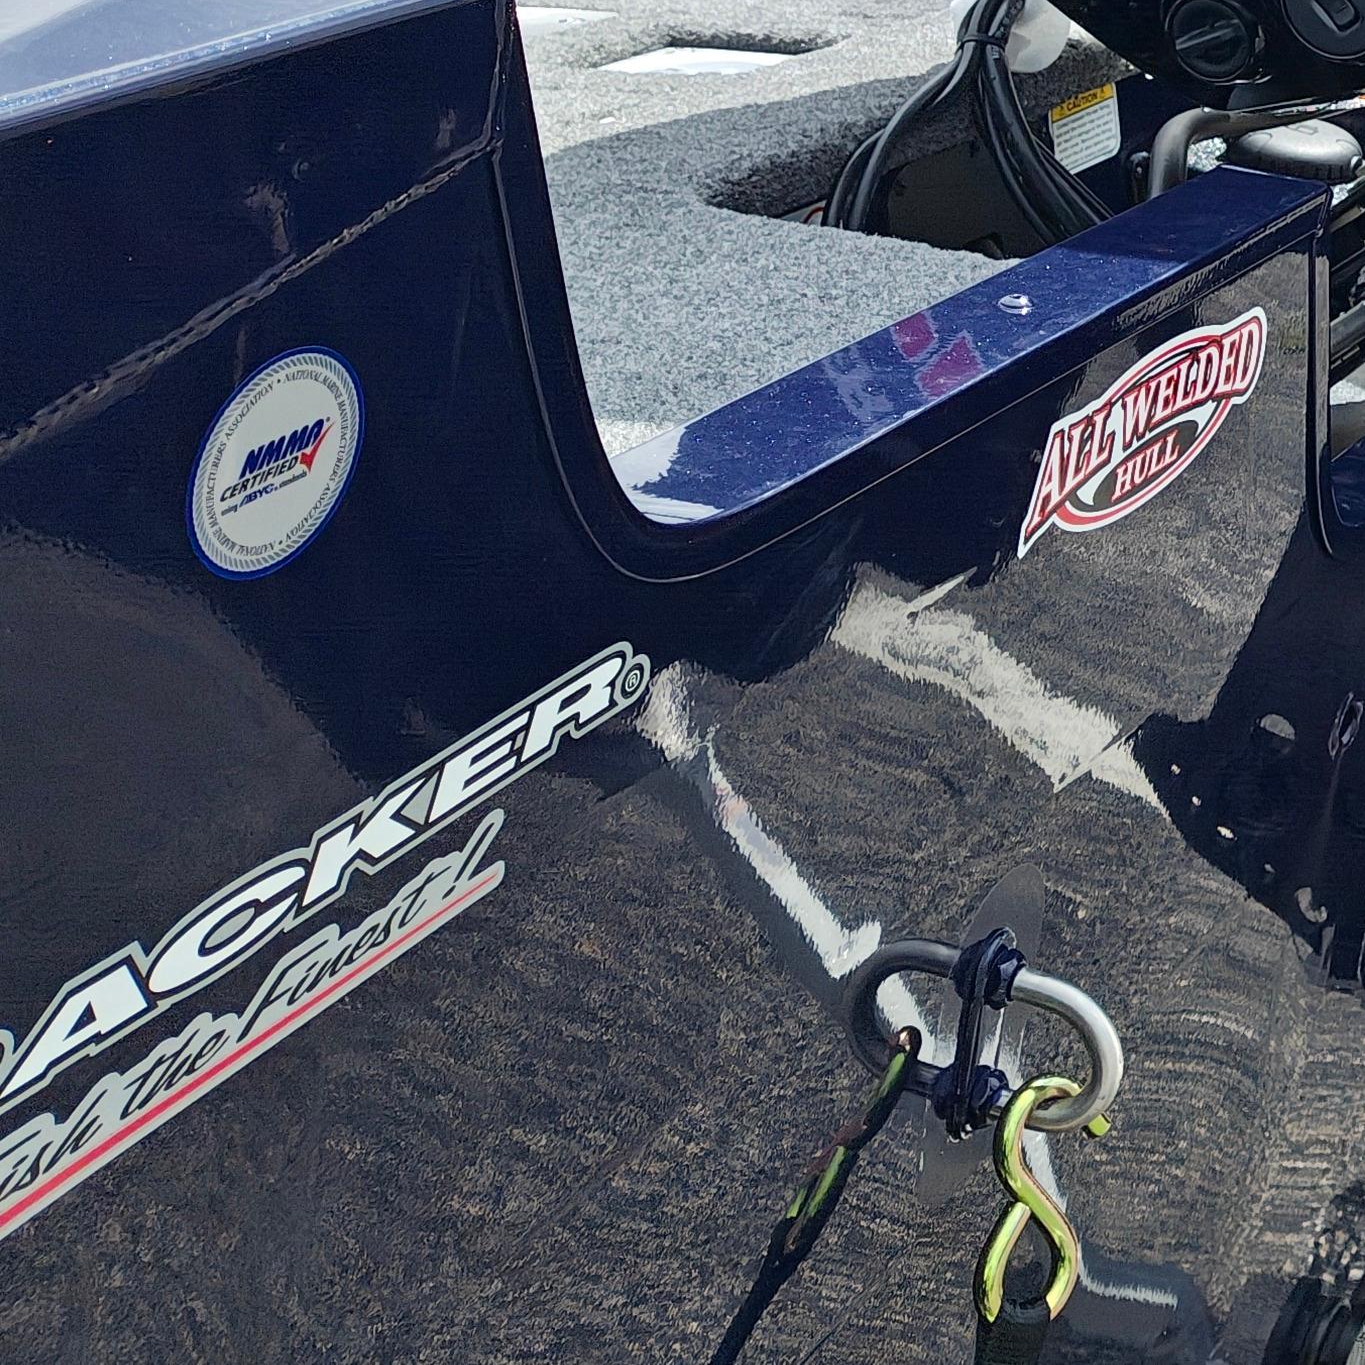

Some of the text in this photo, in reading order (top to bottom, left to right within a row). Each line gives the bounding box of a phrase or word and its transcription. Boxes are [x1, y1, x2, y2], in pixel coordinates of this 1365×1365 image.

[1065, 91, 1099, 112] CAUTION
[283, 368, 323, 387] NATIONAL
[321, 378, 343, 401] MARINE
[205, 441, 227, 529] MANUFACTURERS
[224, 380, 276, 441] ASSOCIATION
[328, 400, 350, 483] MANUFACTURERS
[1024, 316, 1262, 541] ALL WELDED
[220, 455, 299, 502] CERTIFIED
[1111, 429, 1180, 503] HULL
[120, 1028, 230, 1120] the
[237, 822, 495, 1045] Finest!
